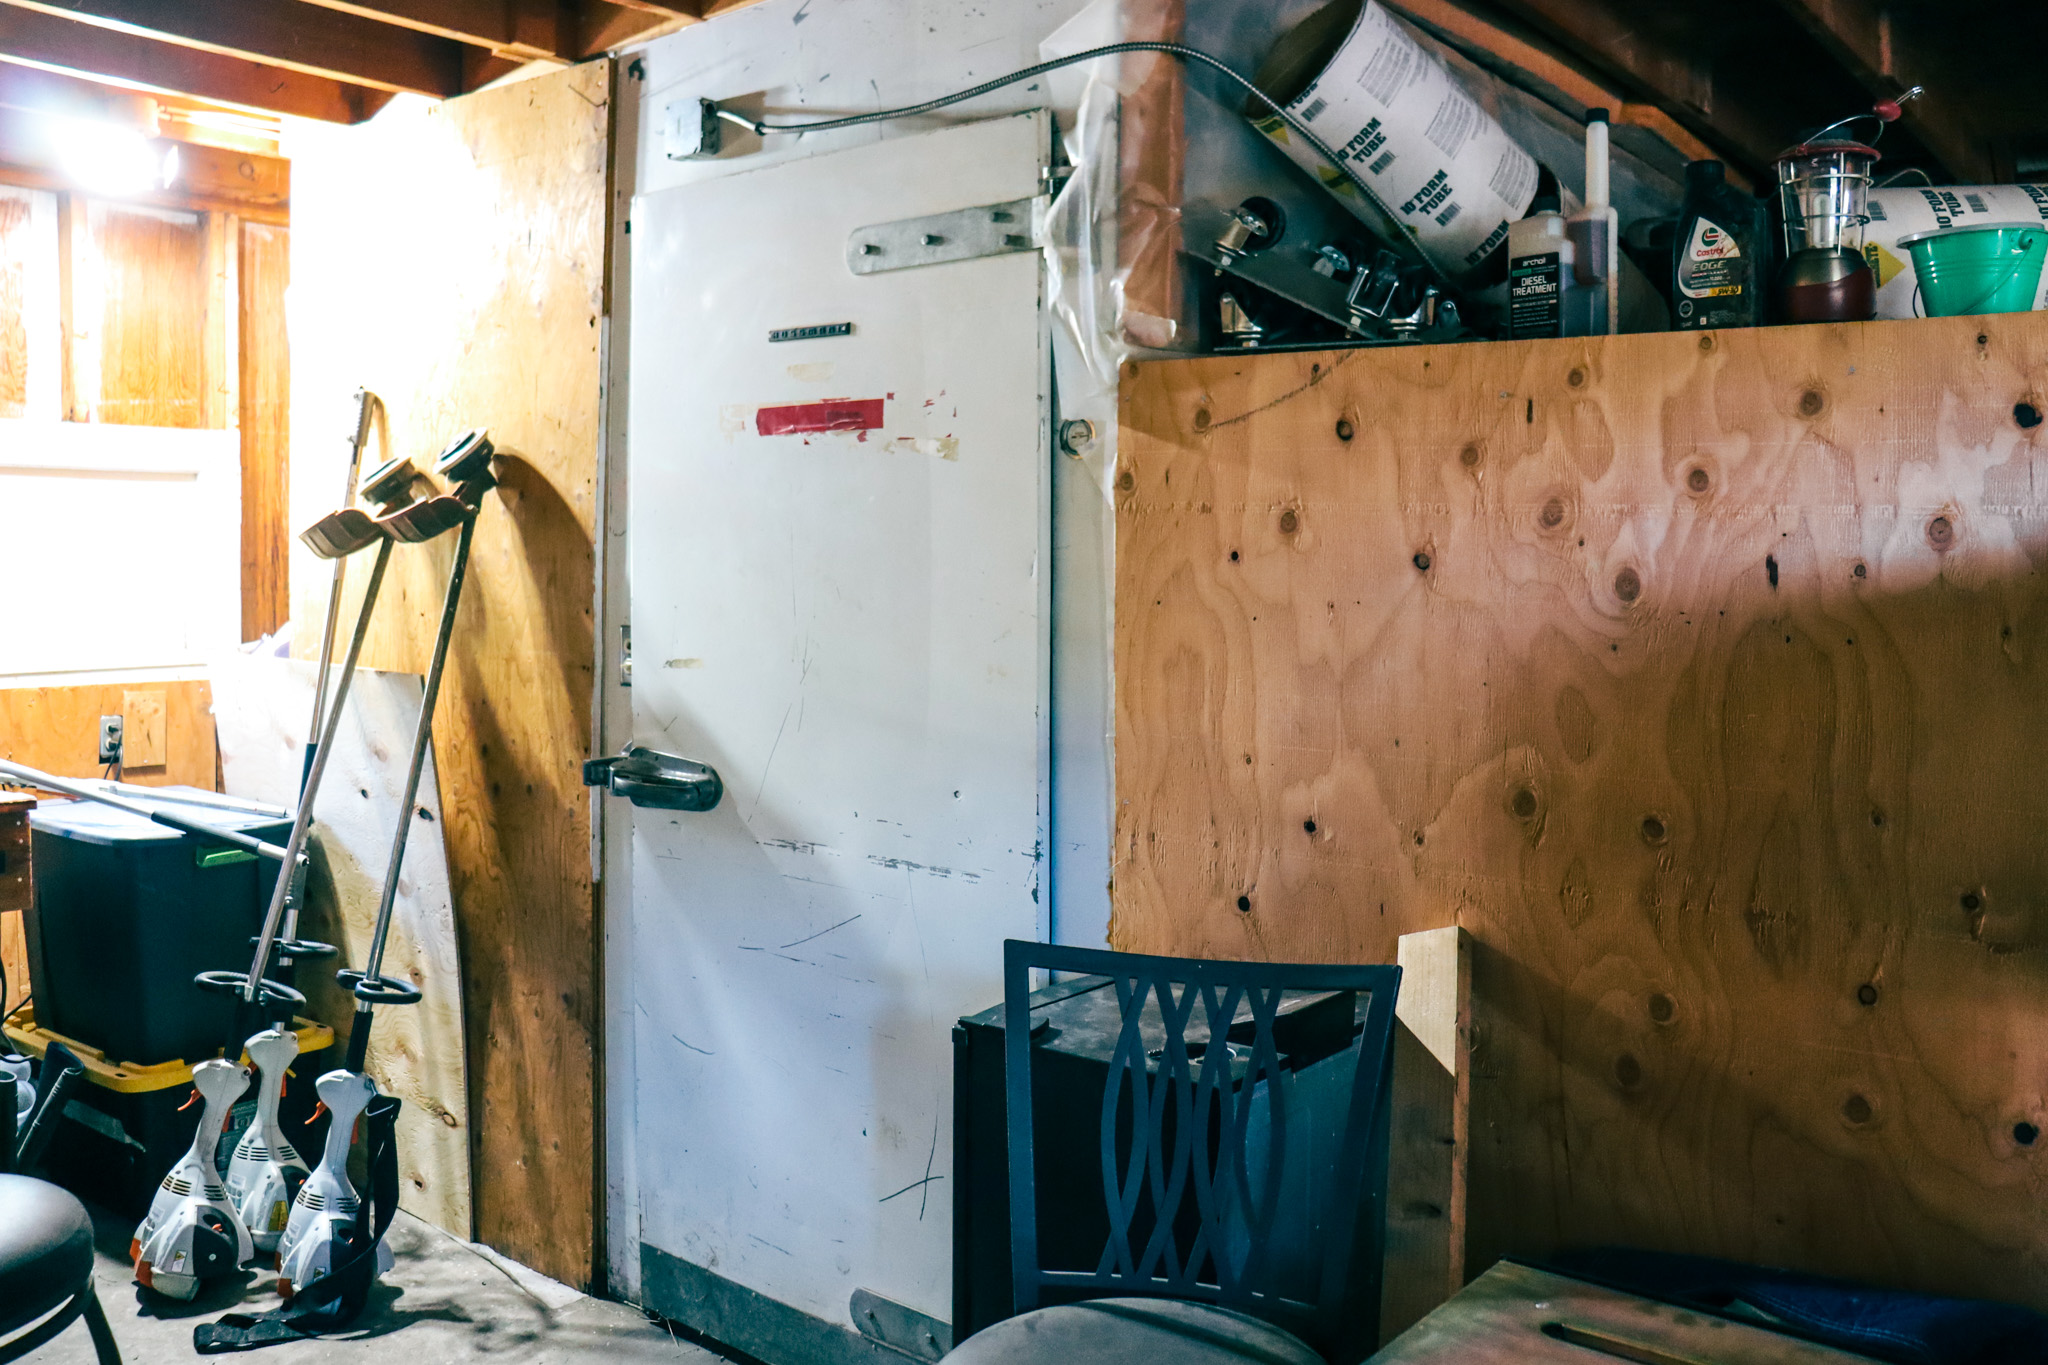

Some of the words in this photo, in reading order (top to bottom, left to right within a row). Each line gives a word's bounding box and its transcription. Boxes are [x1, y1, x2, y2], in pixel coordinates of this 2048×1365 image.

[1346, 116, 1382, 153] FORM
[1352, 131, 1387, 163] TUBE
[1413, 168, 1449, 205] FORM
[1418, 183, 1453, 216] TUBE
[1696, 247, 1724, 257] Castrol
[1693, 260, 1727, 271] EDGE
[1512, 283, 1557, 297] TREATMENT
[1521, 275, 1547, 287] DIESEL
